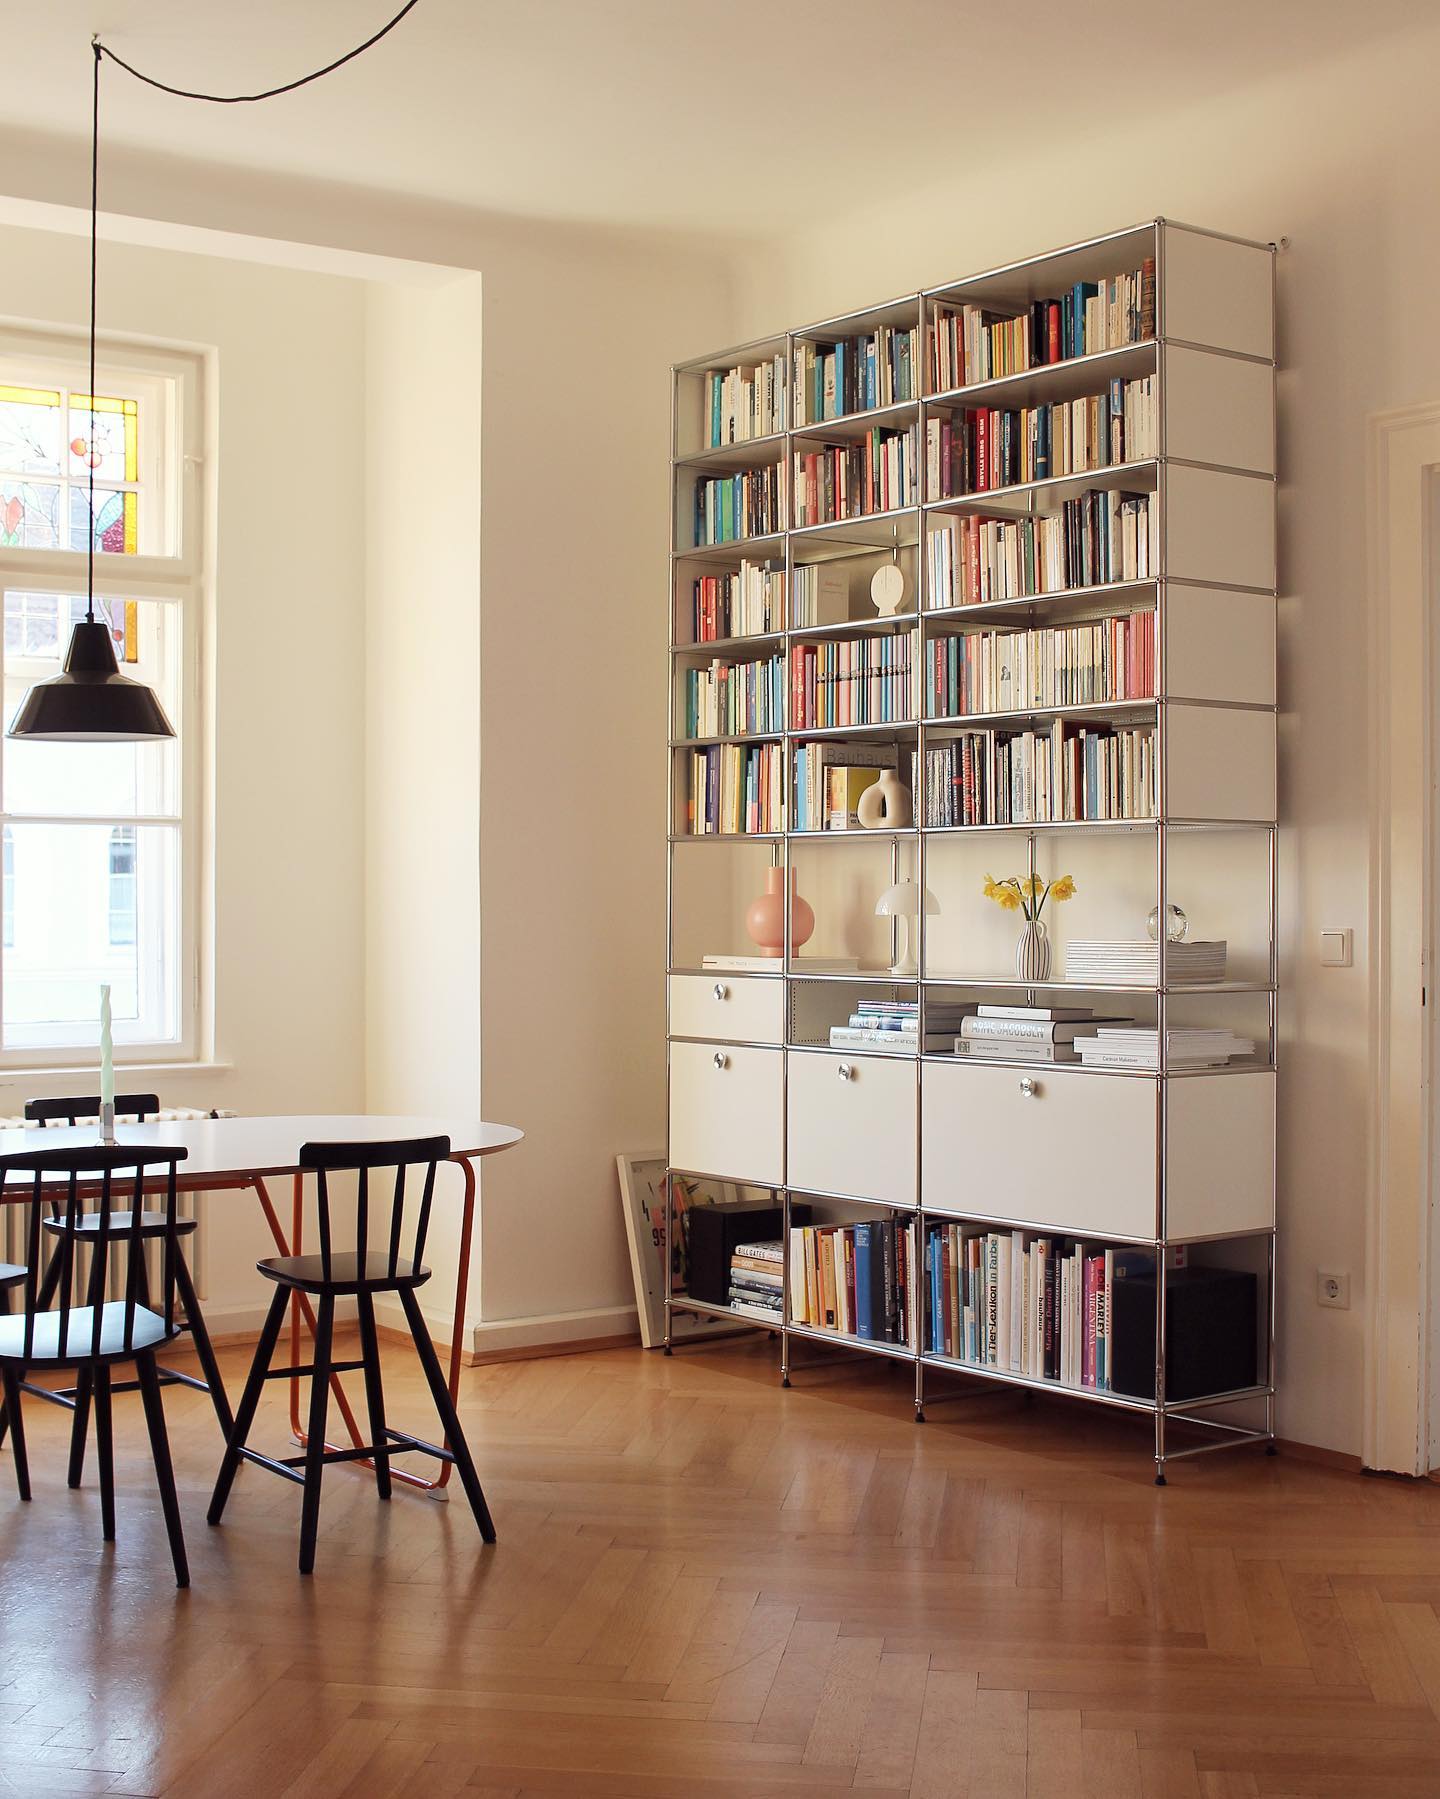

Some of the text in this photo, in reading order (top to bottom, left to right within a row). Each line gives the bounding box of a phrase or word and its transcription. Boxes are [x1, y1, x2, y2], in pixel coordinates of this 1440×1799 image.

[826, 747, 892, 764] Bauhaus
[972, 1021, 1045, 1039] ARNE JACOBSEN
[738, 1247, 766, 1259] BILL GATES
[988, 1239, 997, 1351] Tier-Lexikon in Farbe
[1097, 1268, 1105, 1335] BOB MARLEY
